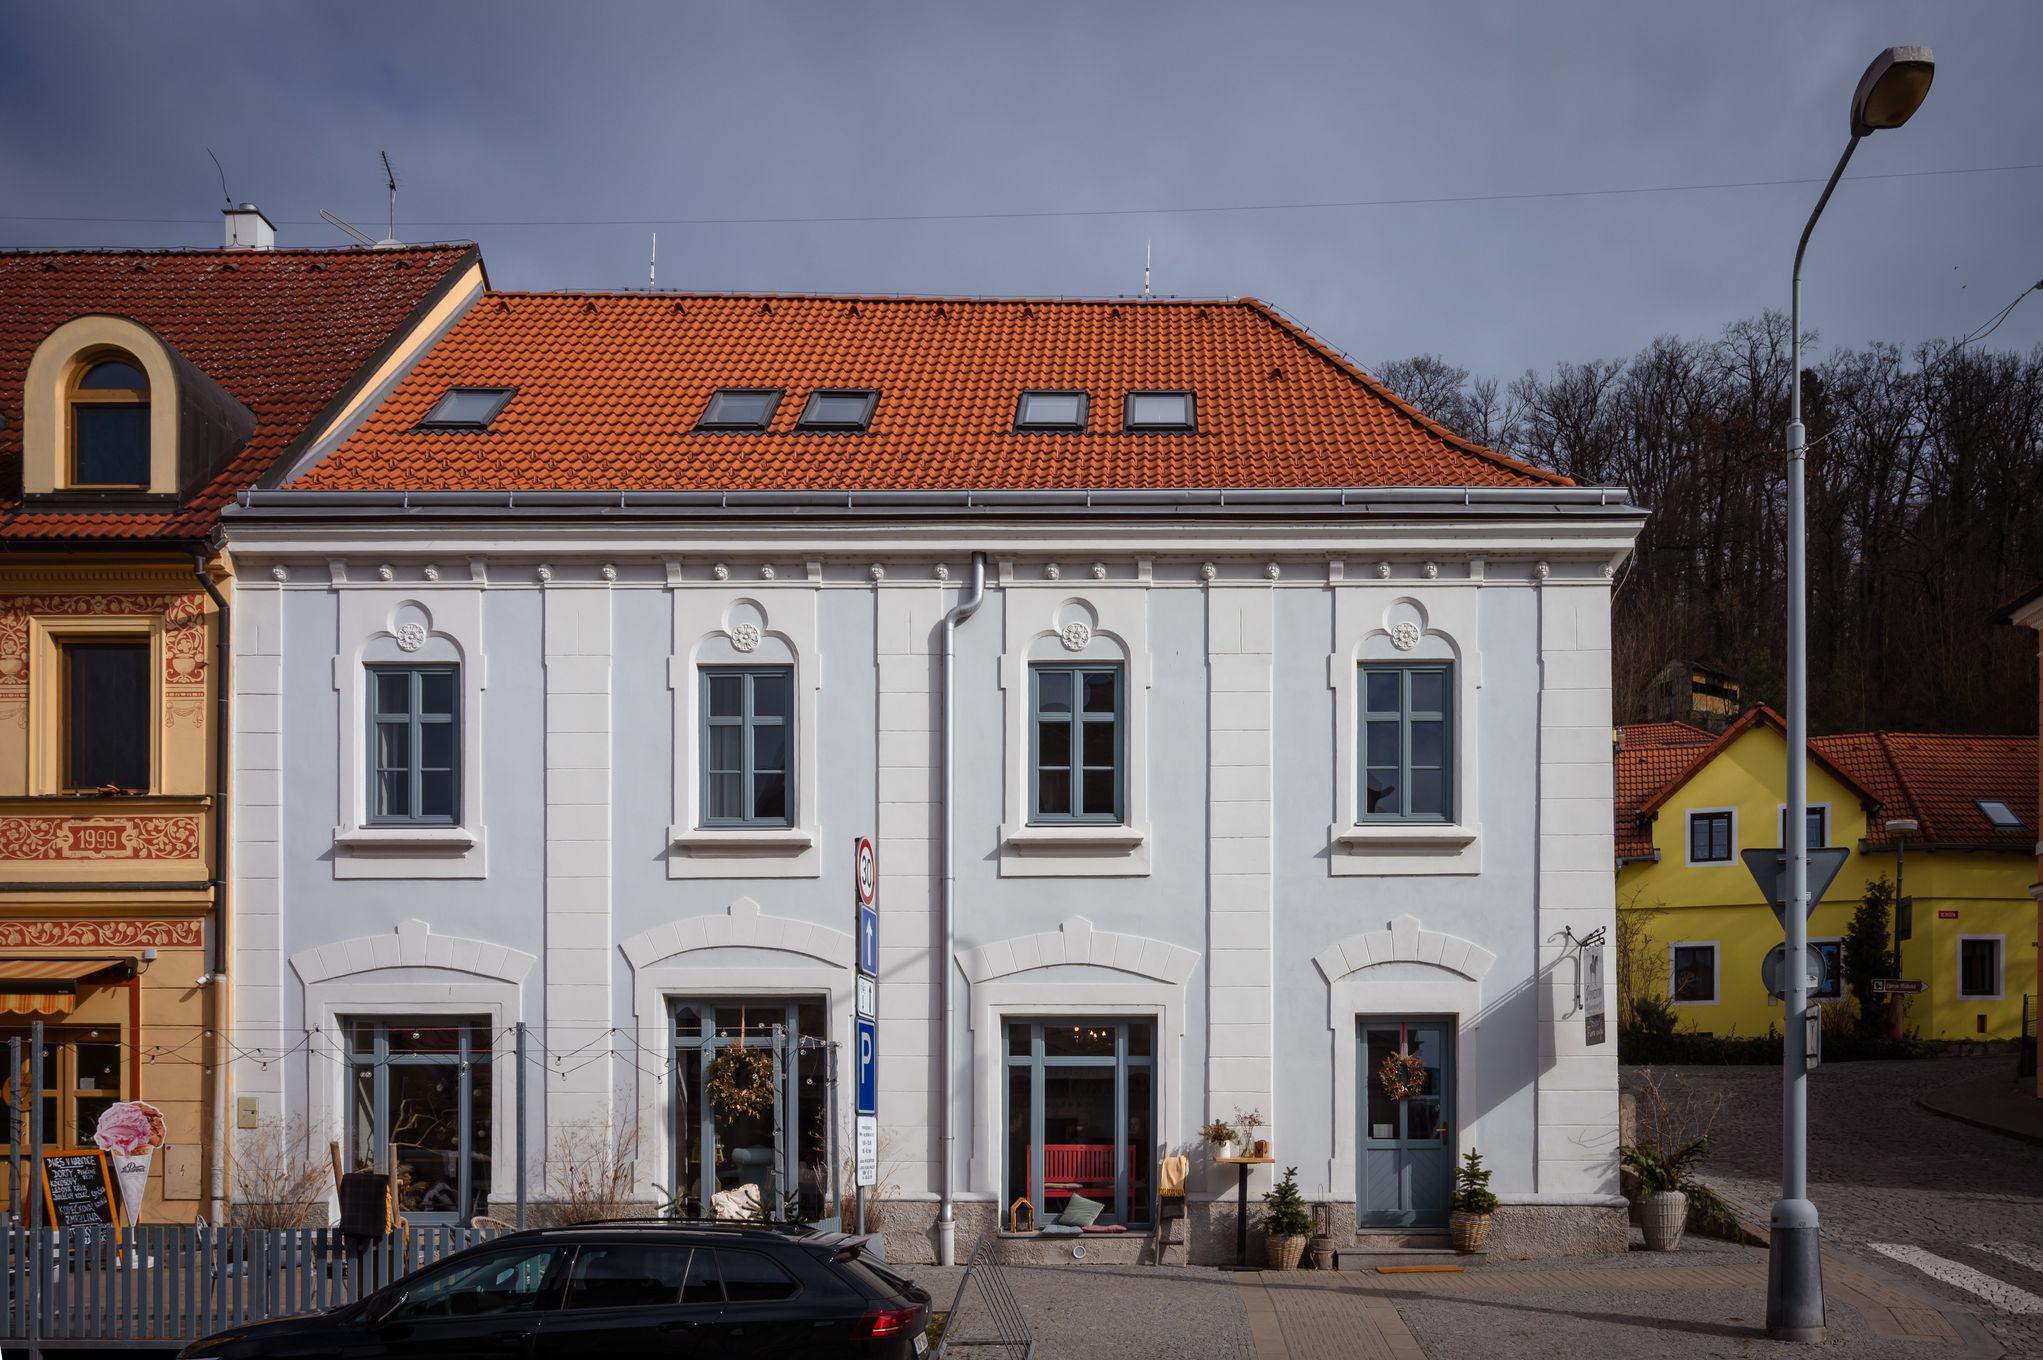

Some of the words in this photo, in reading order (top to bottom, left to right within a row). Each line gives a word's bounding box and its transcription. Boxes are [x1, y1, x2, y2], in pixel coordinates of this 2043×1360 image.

[77, 829, 118, 849] 1999
[861, 855, 872, 889] 30
[861, 1031, 871, 1084] P
